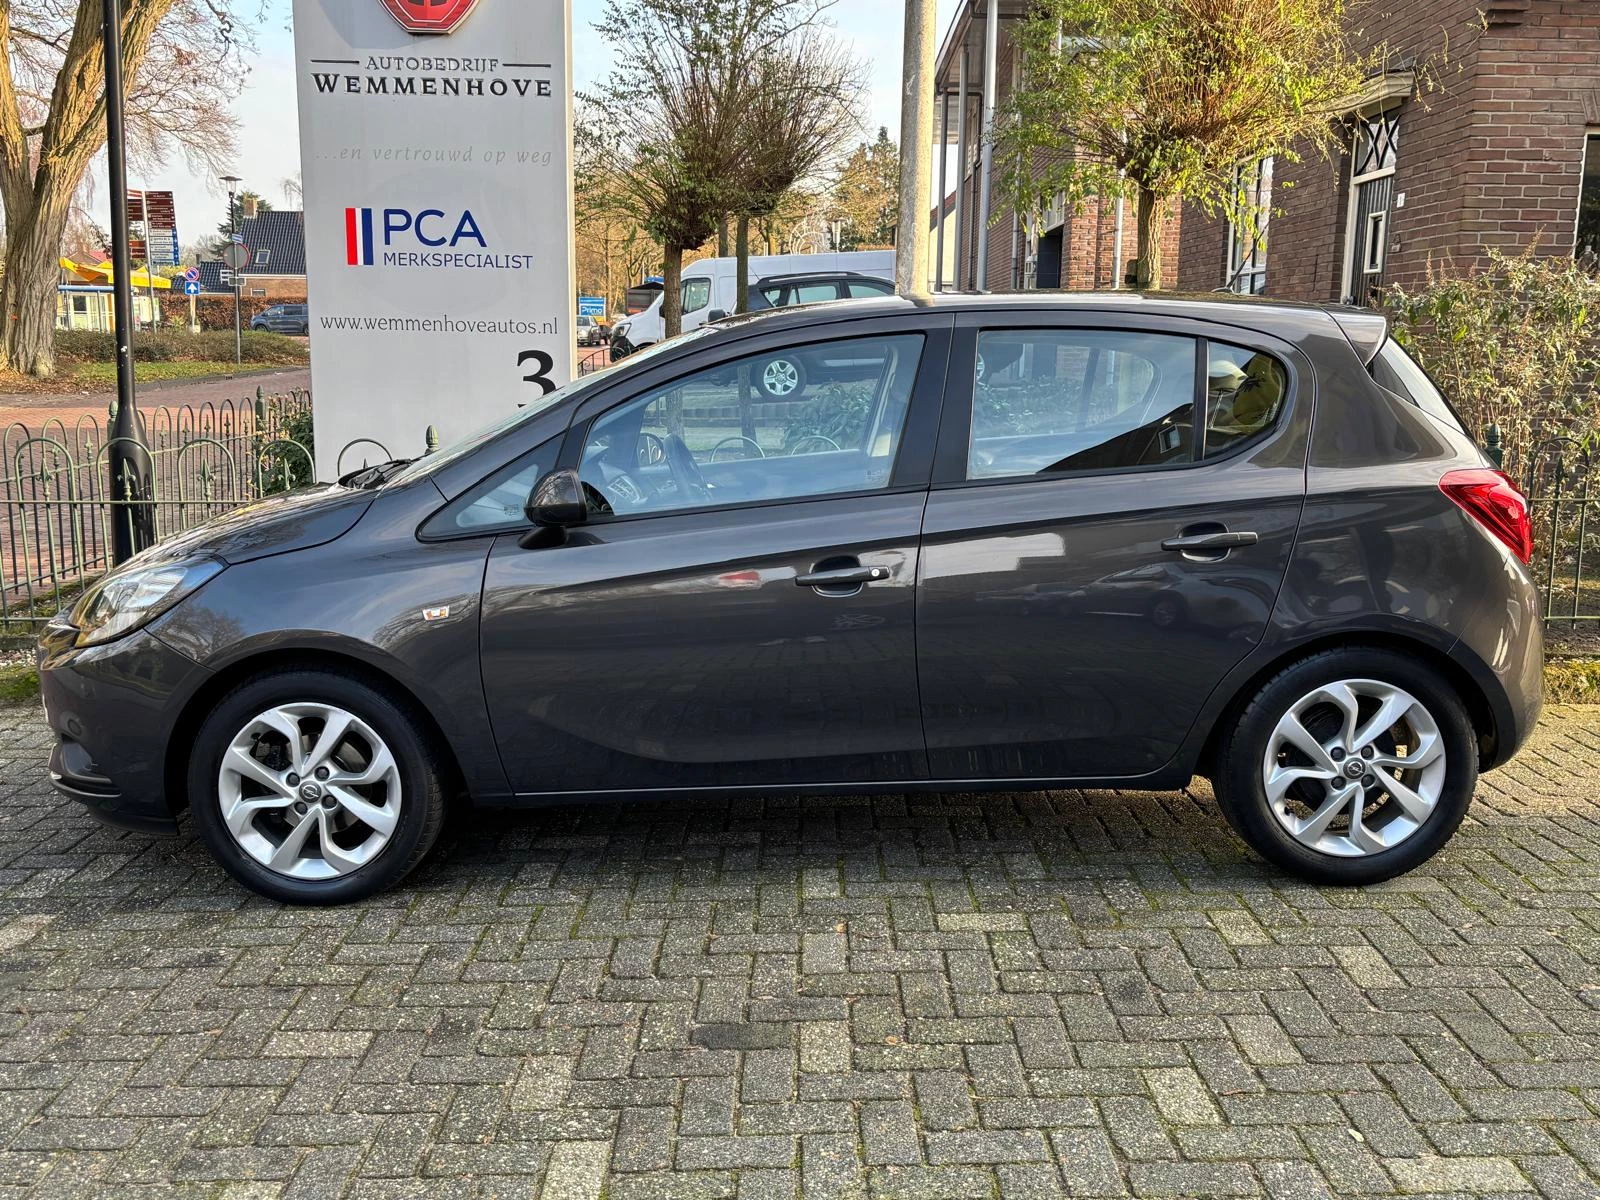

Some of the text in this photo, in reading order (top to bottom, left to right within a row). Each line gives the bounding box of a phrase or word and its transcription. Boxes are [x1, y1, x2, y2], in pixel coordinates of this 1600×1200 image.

[365, 56, 499, 72] AUTOBEDRIJF
[311, 73, 551, 97] WEMMENHOVE
[373, 146, 473, 162] vertrouwd
[484, 151, 506, 164] op
[517, 150, 552, 166] weg
[383, 208, 487, 248] PCA
[383, 252, 533, 269] MERKSPECIALIST
[320, 315, 558, 335] www.wemmenhoveautos.nl
[516, 349, 557, 408] 3
